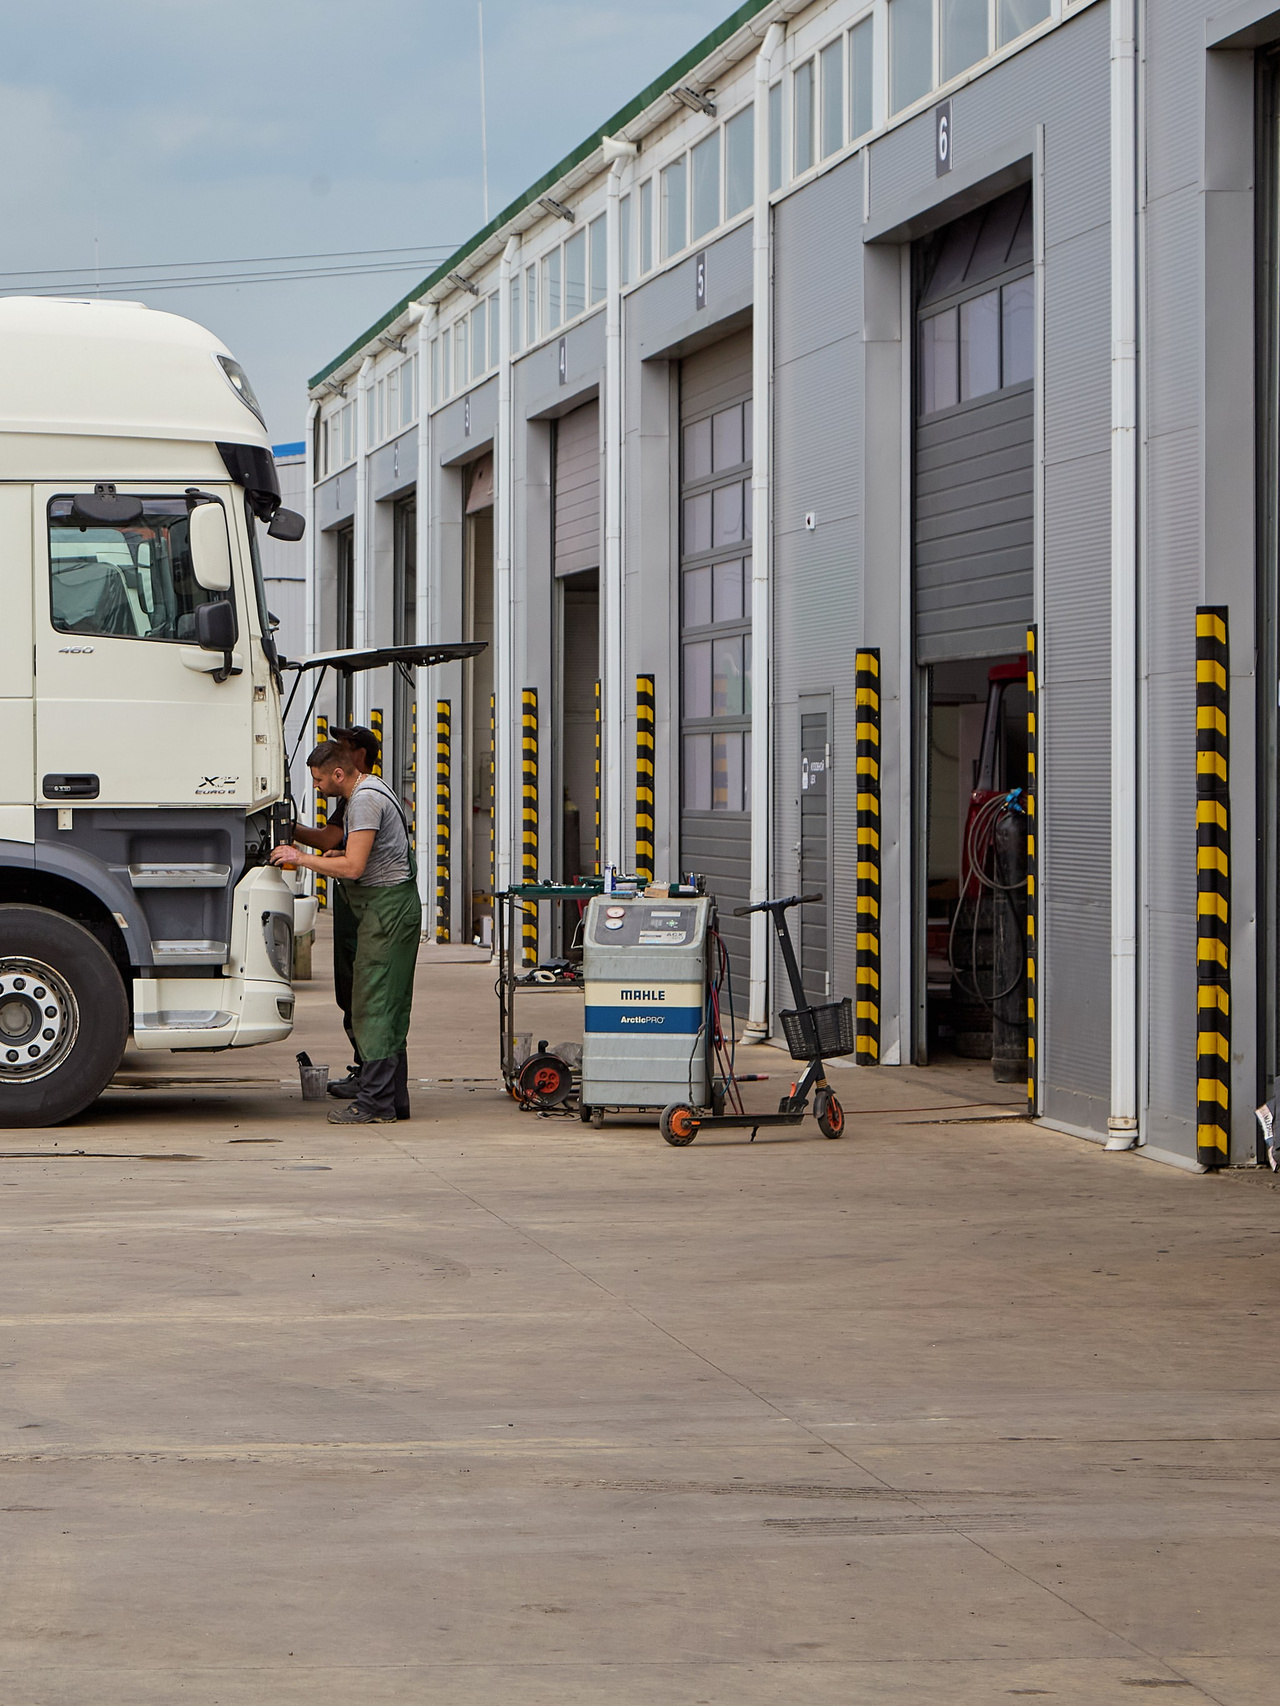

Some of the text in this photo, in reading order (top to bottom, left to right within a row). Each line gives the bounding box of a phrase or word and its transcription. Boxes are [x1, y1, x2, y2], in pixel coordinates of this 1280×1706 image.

[939, 115, 948, 161] 6
[698, 264, 704, 297] 5
[58, 645, 95, 654] 460
[620, 990, 666, 1001] MAHLE
[620, 1015, 665, 1024] ArcticPRO
